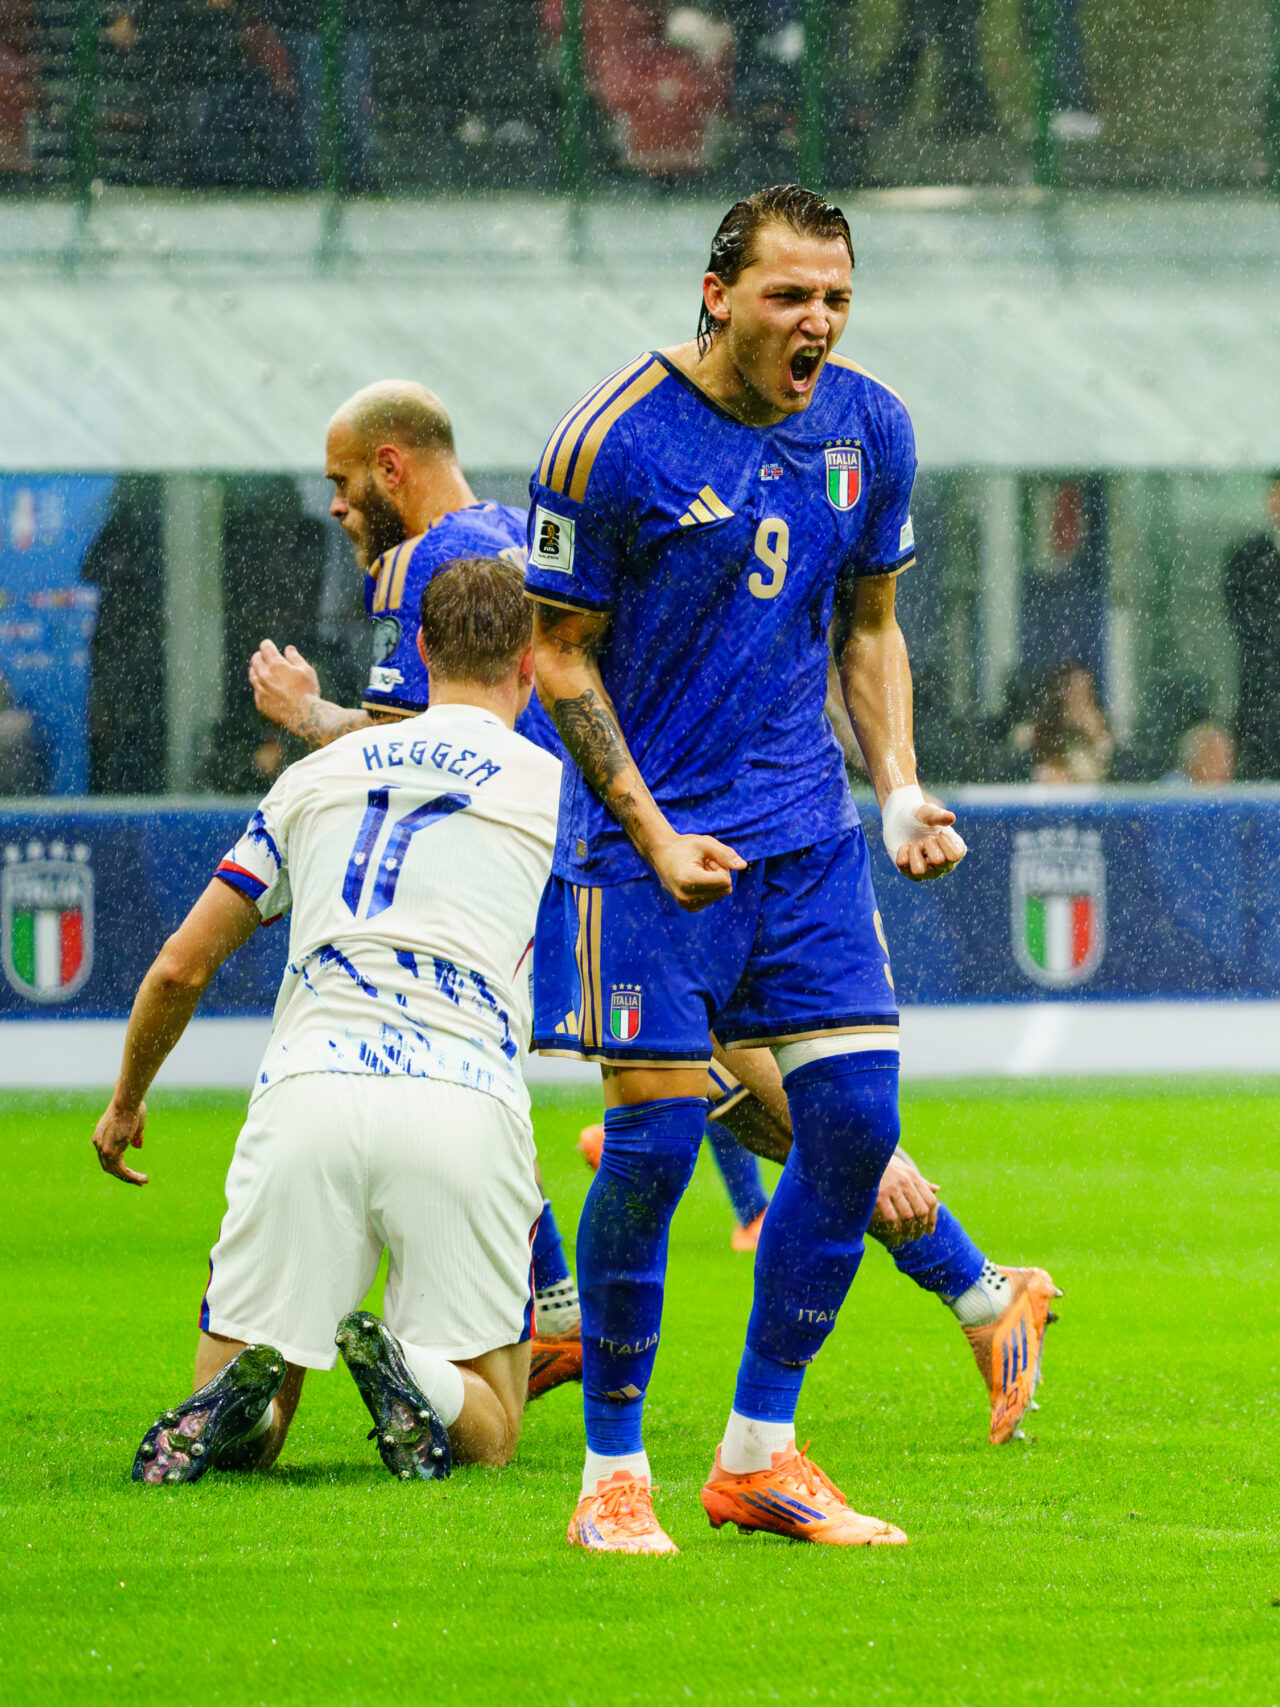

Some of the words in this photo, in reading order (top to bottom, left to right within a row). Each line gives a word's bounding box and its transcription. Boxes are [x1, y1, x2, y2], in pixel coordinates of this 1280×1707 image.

[828, 453, 858, 465] ITALIA
[748, 518, 790, 599] 9
[362, 741, 502, 787] HEGGEM
[613, 995, 638, 1006] ITALIA
[599, 1332, 658, 1355] ITALIA
